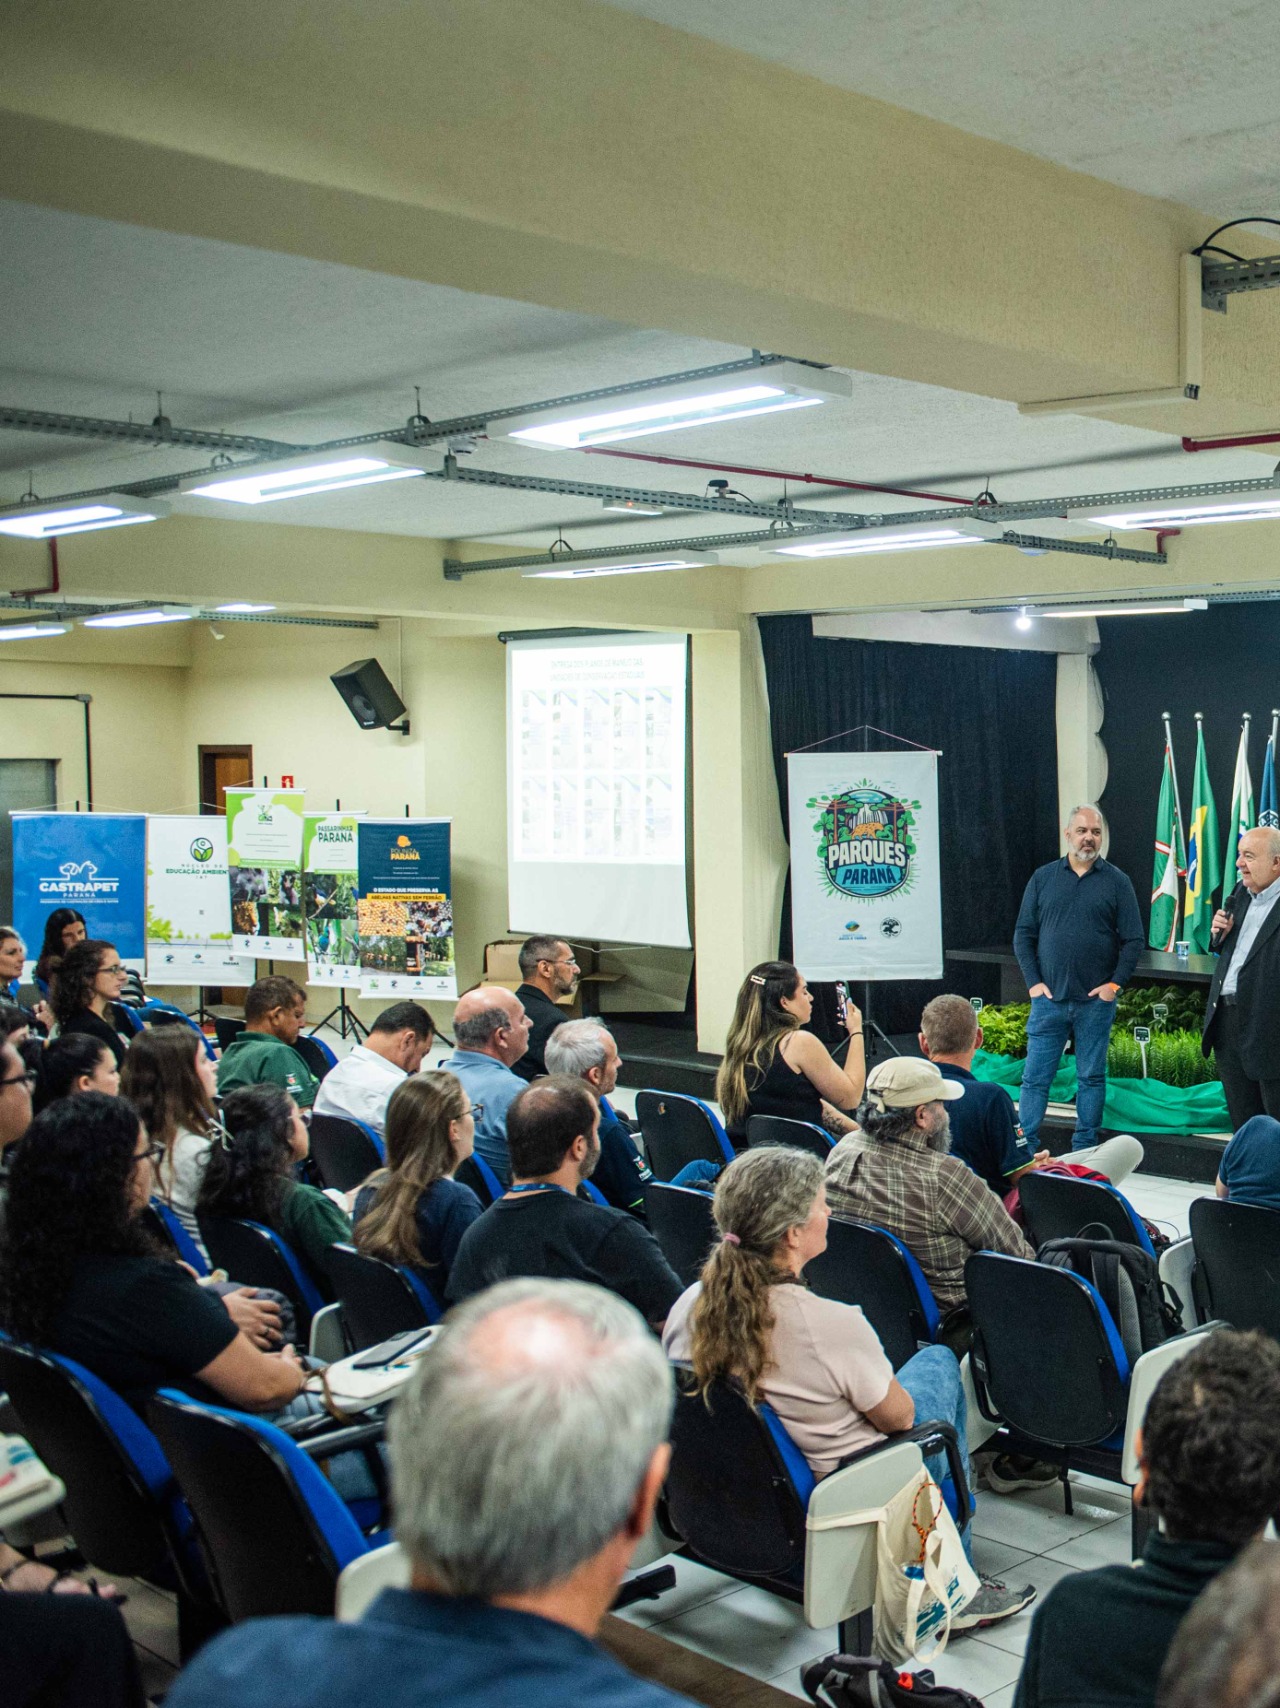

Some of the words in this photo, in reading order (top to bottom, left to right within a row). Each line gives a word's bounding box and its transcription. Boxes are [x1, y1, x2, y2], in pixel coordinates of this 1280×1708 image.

[828, 840, 906, 868] PARQUES
[165, 867, 200, 875] EDUCAÇÃO
[842, 866, 898, 885] PARANÁ
[39, 881, 120, 892] CASTRAPET
